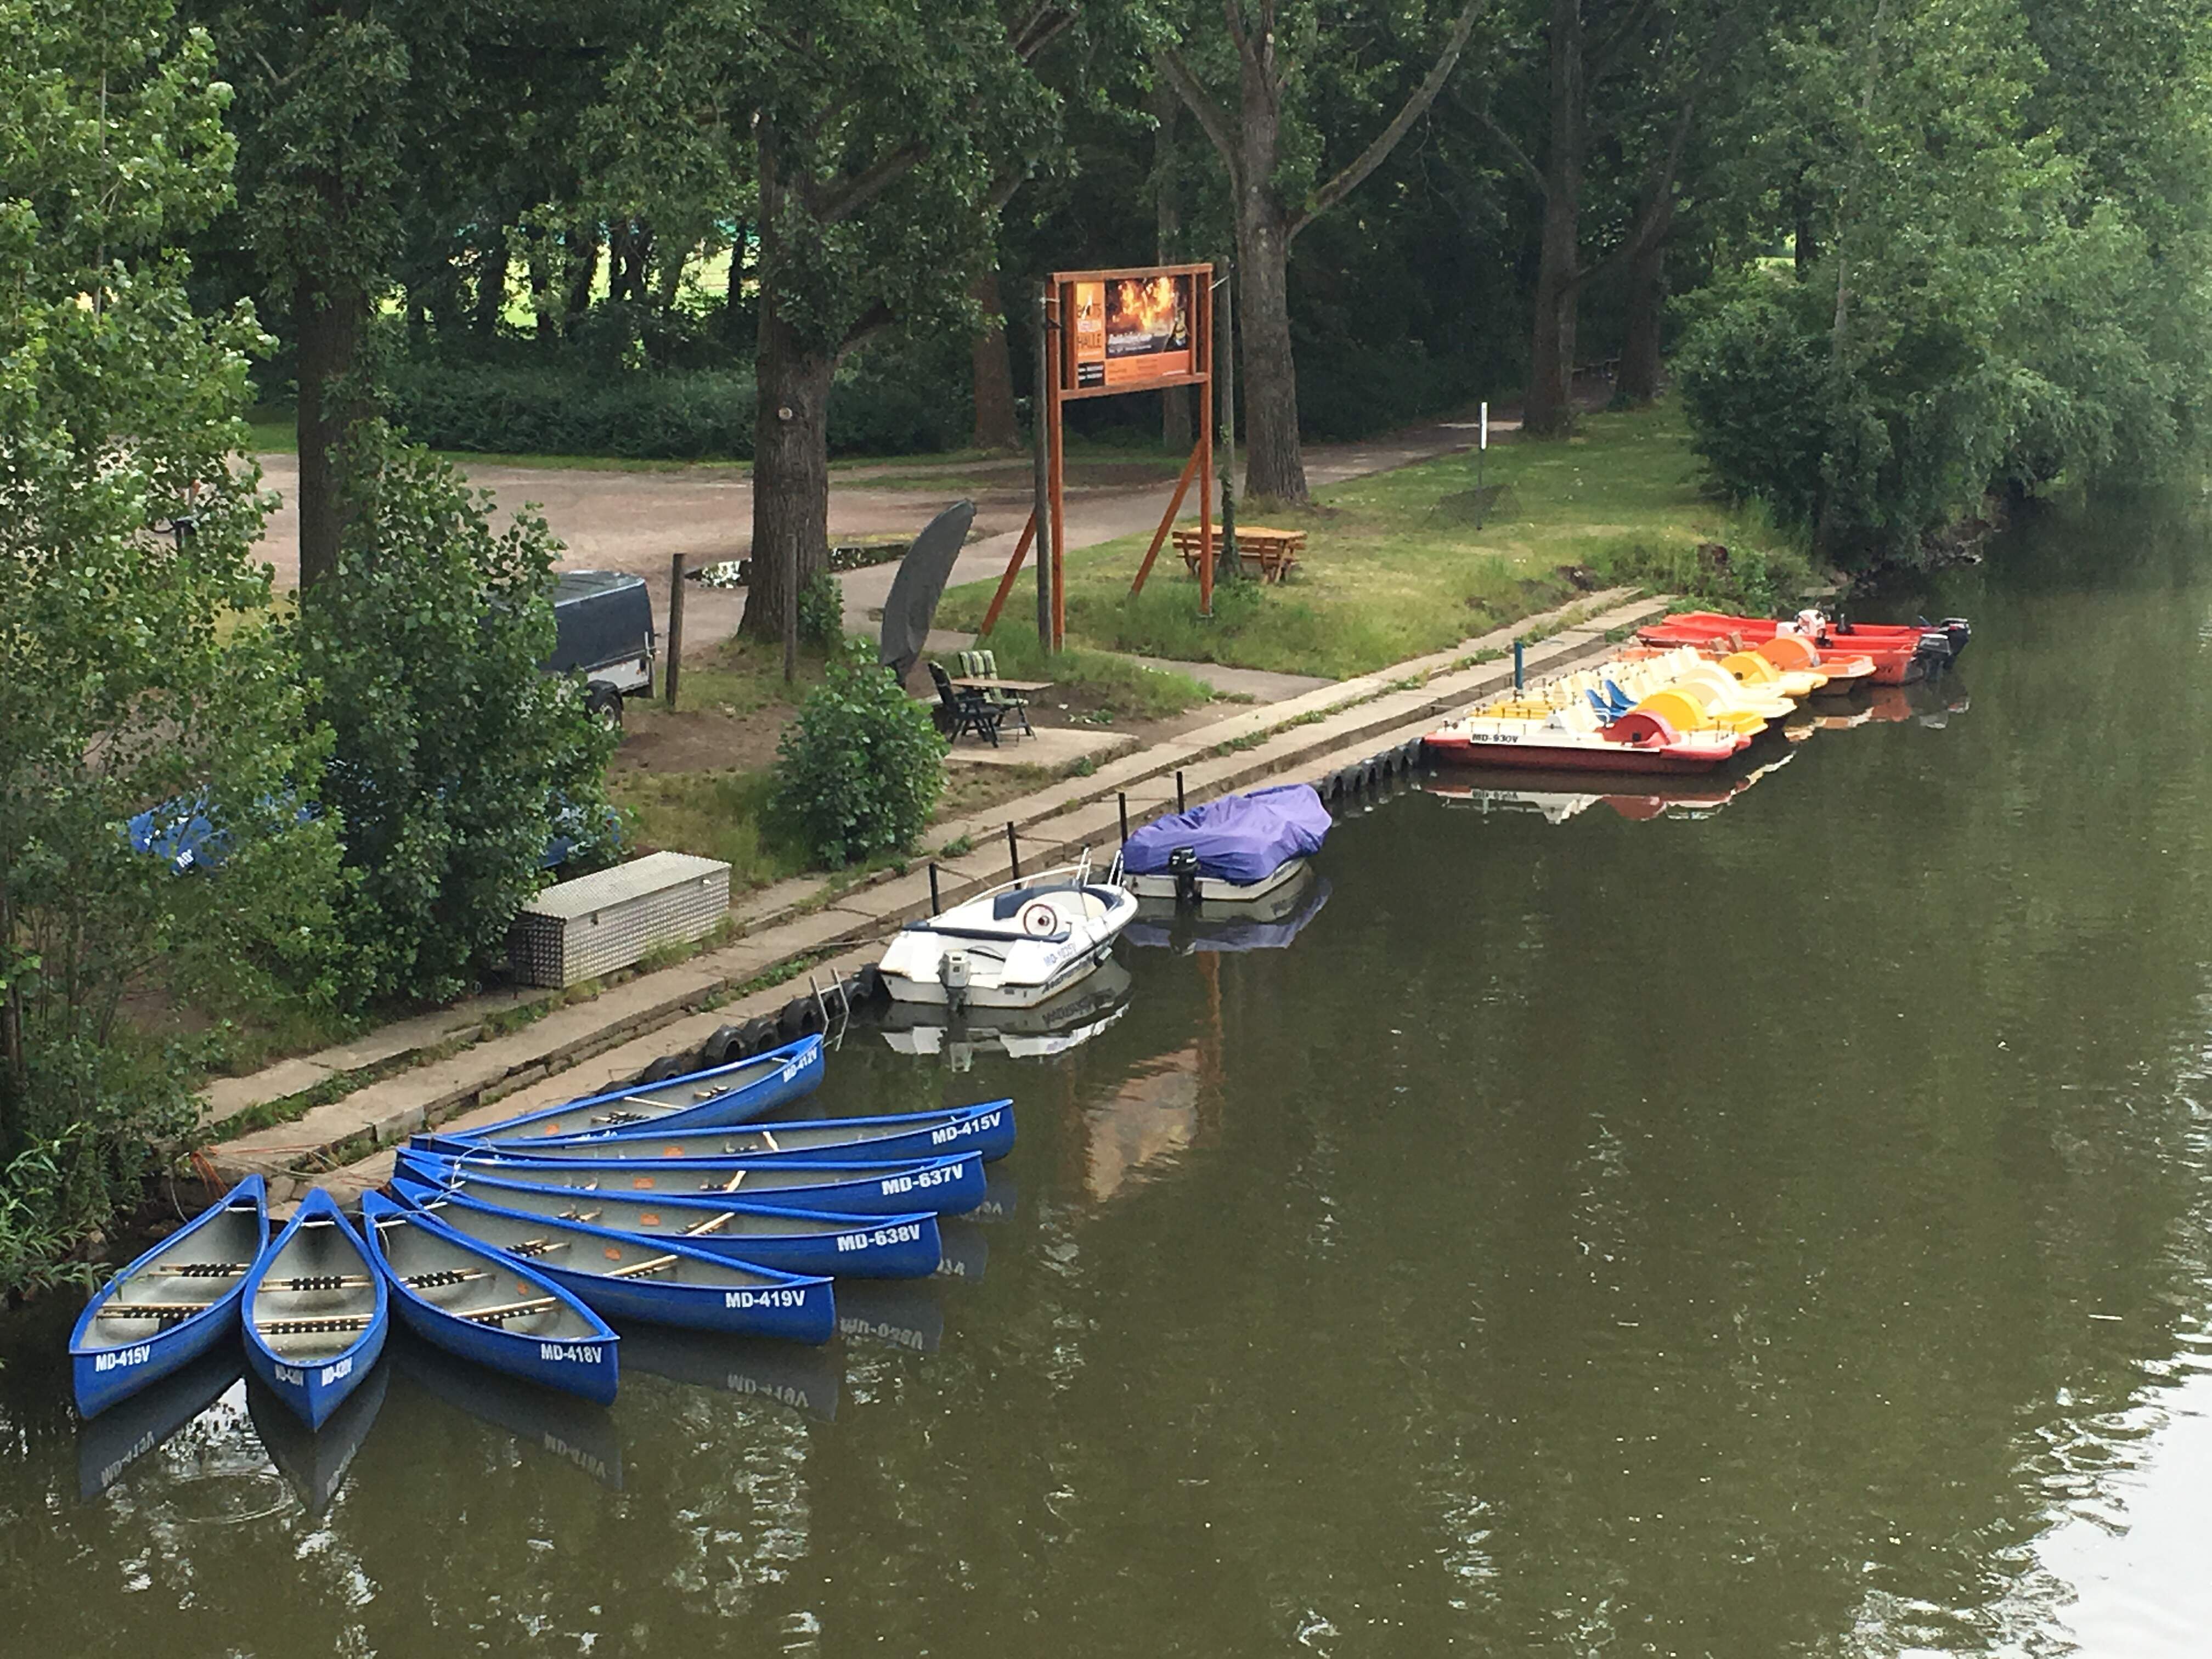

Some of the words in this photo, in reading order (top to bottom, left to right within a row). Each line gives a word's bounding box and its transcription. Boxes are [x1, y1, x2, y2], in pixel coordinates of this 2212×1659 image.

[932, 1111, 1001, 1145] MD-415V
[881, 1163, 963, 1195] MD-637V
[837, 1224, 920, 1252] MD-638V
[725, 1290, 805, 1308] MD-419V
[541, 1343, 602, 1363] MD-418V
